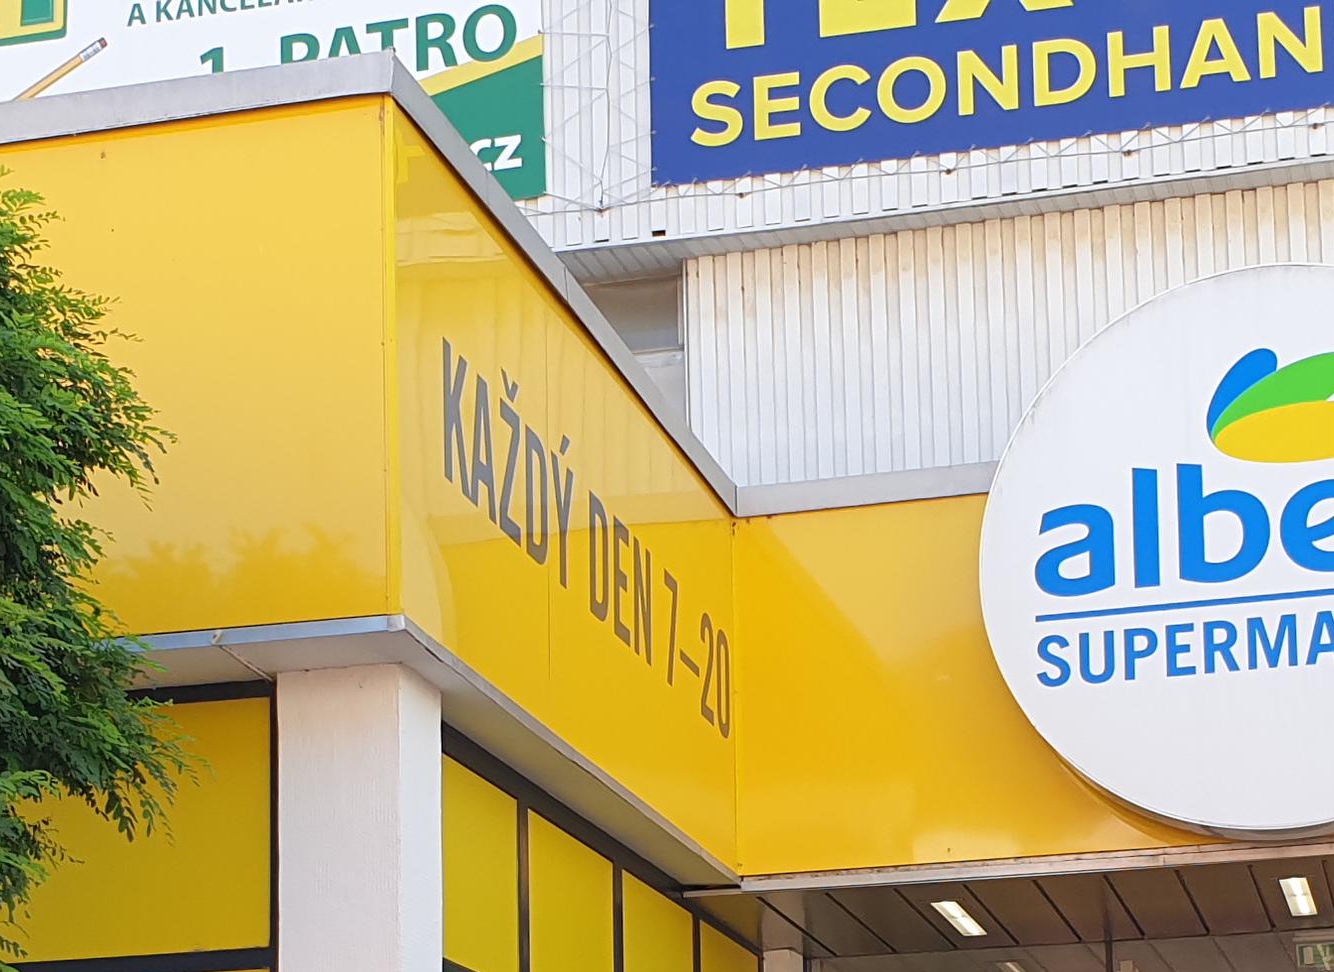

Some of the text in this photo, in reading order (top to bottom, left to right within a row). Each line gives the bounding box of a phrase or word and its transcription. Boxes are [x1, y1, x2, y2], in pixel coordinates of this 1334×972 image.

[127, 3, 148, 27] A
[442, 336, 575, 590] KAŽDÝ
[588, 488, 653, 667] DEN
